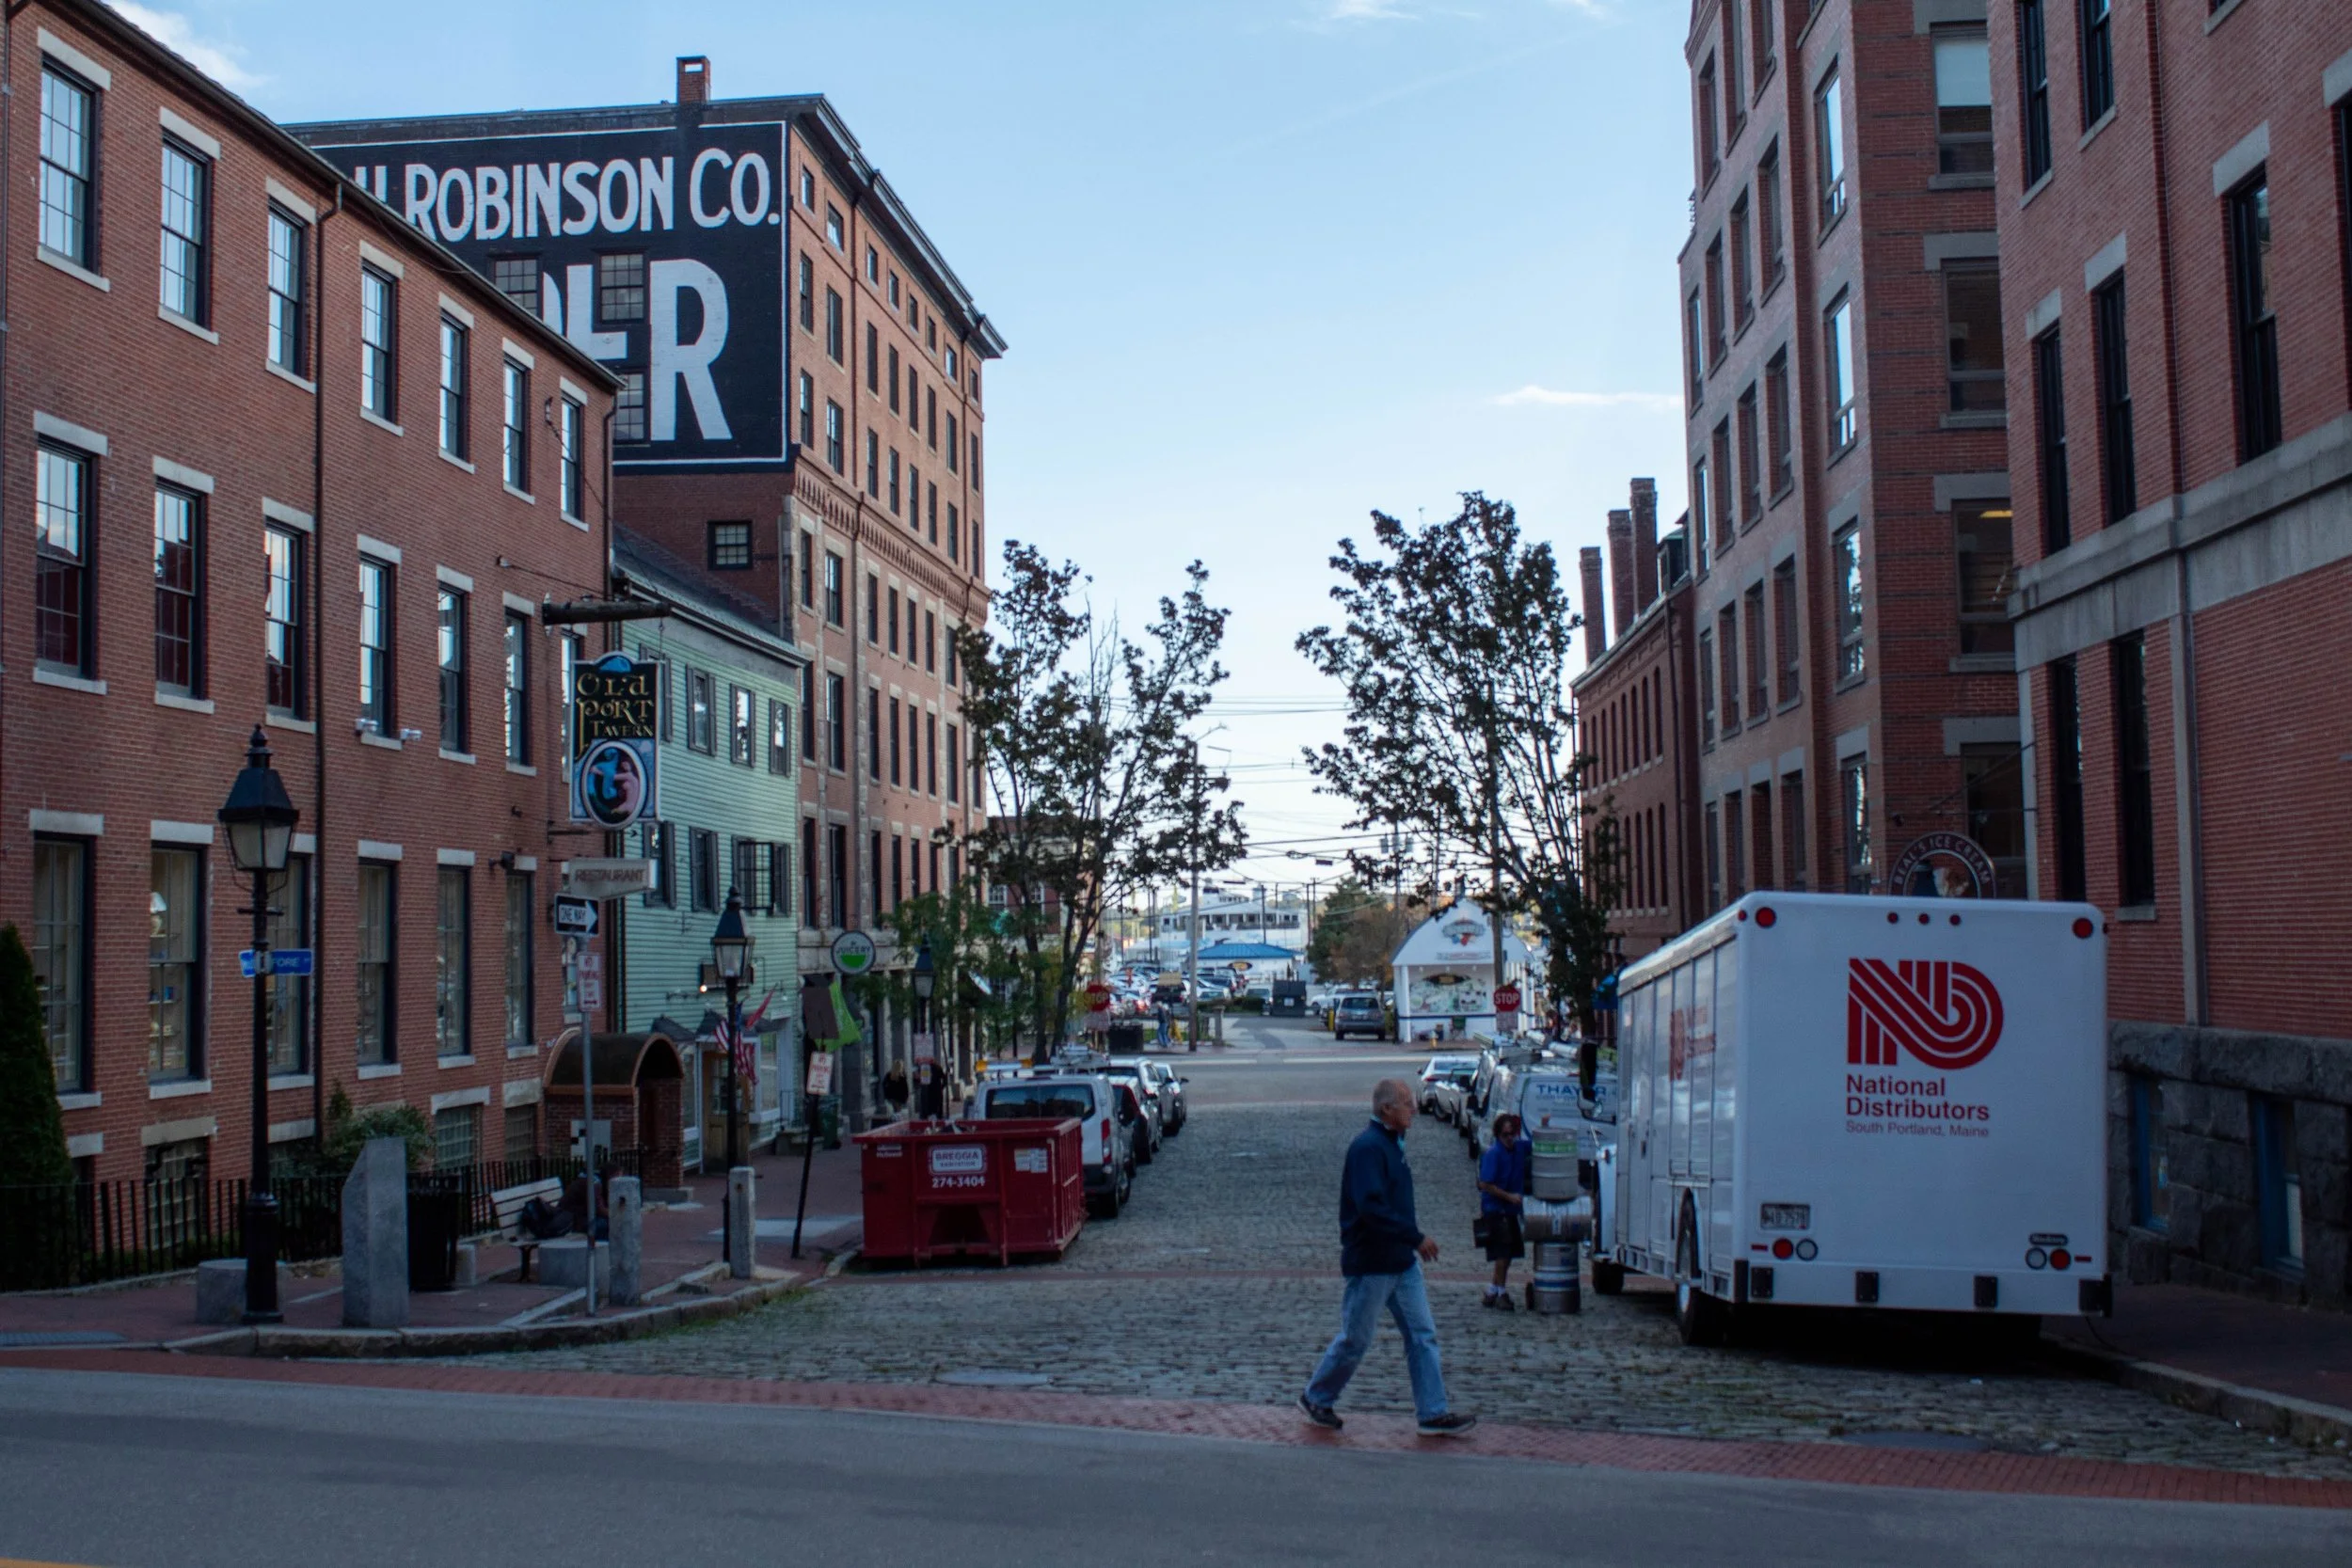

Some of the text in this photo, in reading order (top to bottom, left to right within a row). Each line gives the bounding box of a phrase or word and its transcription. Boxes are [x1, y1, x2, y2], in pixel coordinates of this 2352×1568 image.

[405, 156, 675, 242] ROBINSON
[690, 148, 781, 229] CO.
[591, 720, 654, 737] TAVERN
[1930, 834, 1951, 848] ICE
[560, 907, 586, 923] ONE WAY
[1086, 992, 1108, 1005] TOP
[1495, 992, 1519, 1006] STOP
[1536, 1084, 1607, 1095] THAYR
[1846, 1074, 1946, 1098] National
[1846, 1097, 1990, 1121] Distributors
[1846, 1120, 1990, 1137] South Portland, Maine
[931, 1176, 986, 1189] 274-3404
